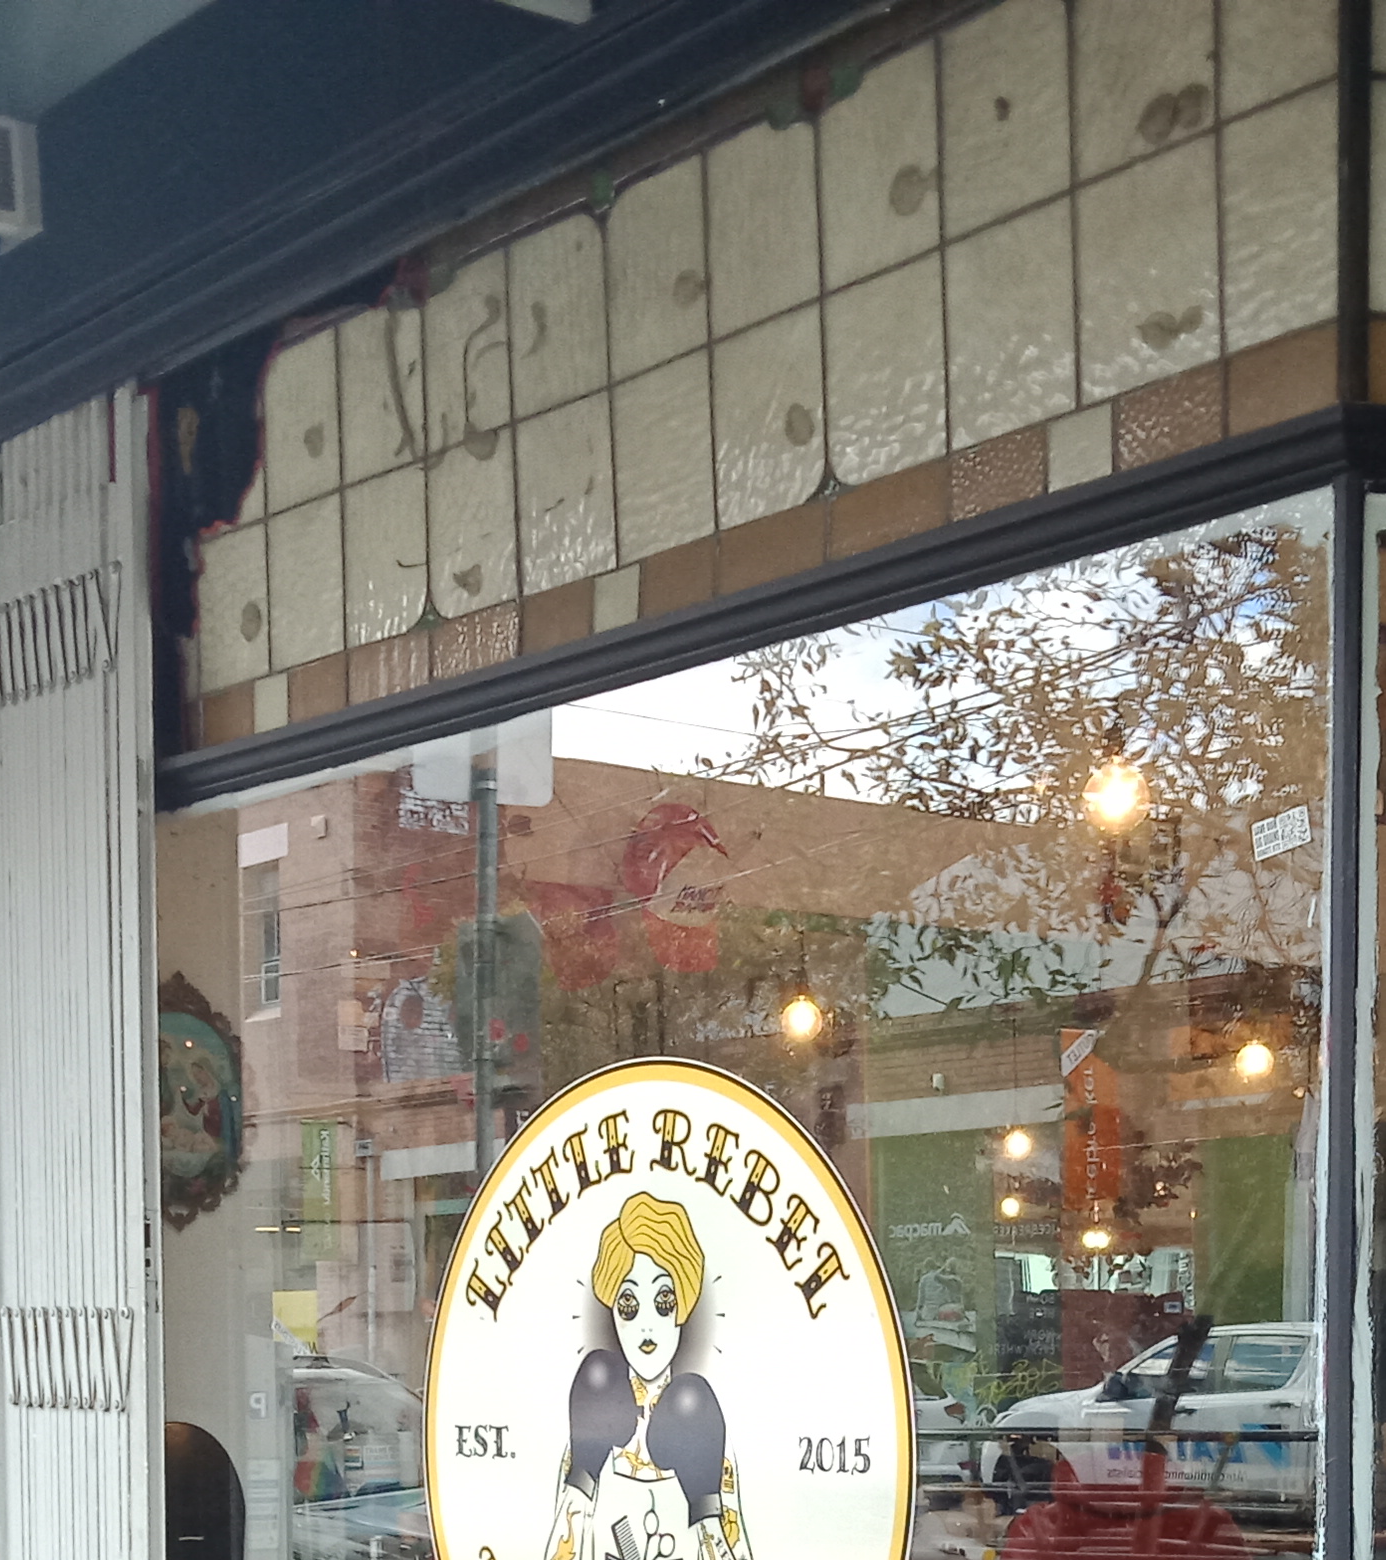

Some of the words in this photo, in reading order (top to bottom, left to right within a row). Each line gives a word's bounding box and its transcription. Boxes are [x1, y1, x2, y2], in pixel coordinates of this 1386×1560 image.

[465, 1109, 635, 1322] LITTLE
[649, 1109, 851, 1320] REBEL
[454, 1424, 517, 1460] EST.
[798, 1435, 873, 1476] 2015
